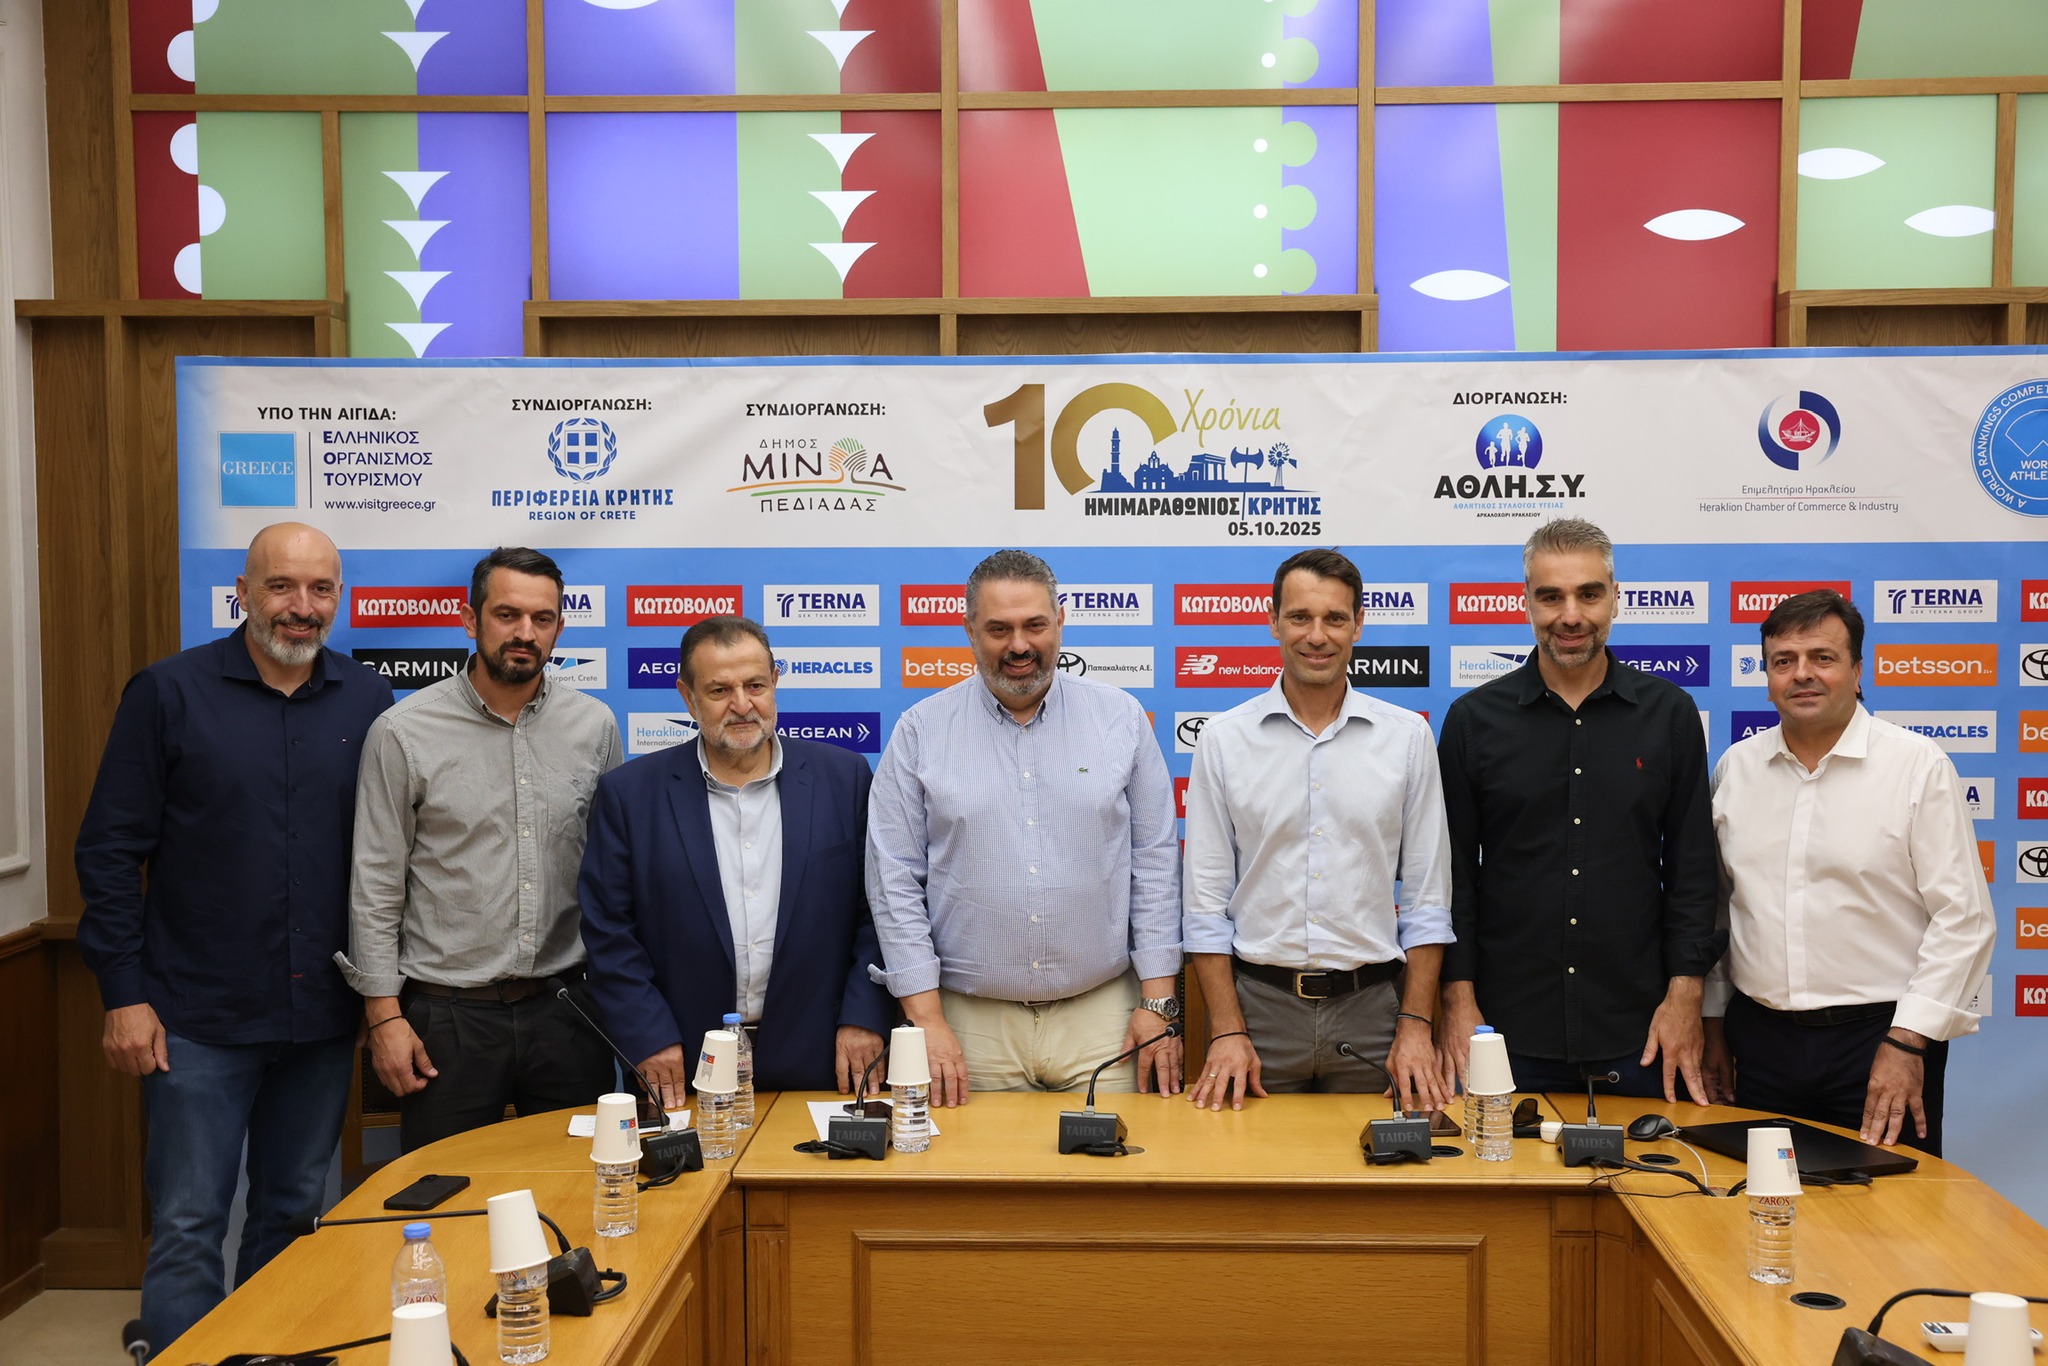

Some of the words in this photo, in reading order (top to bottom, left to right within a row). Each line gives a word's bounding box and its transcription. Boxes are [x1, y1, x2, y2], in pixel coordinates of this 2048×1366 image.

[1452, 392, 1567, 404] ΔΙΟΡΓΑΝΩΣΗ:
[2000, 384, 2048, 407] COMPET
[512, 399, 652, 411] ΣΥΝΔΙΟΡΓΑΝΩΣΗ:
[746, 404, 886, 416] ΣΥΝΔΙΟΡΓΑΝΩΣΗ:
[258, 407, 293, 420] ΥΠΟ
[299, 408, 332, 420] ΤΗΝ
[338, 408, 396, 420] ΑΙΓΙΔΑ:
[1182, 389, 1281, 448] Χρόνια
[323, 431, 420, 444] ΕΛΛΗΝΙΚΟΣ
[1977, 406, 2002, 466] RANKINGS
[760, 439, 817, 448] ΔΗΜΟΣ
[984, 382, 1178, 510] 10
[323, 452, 432, 465] ΟΡΓΑΝΙΣΜΟΣ
[2020, 460, 2048, 470] WOR
[222, 462, 294, 475] GREECE
[324, 473, 422, 486] ΤΟΥΡΙΣΜΟΥ
[2009, 471, 2048, 480] ATHLE
[1434, 474, 1586, 499] ΑΘΛΗ.Σ.Υ.
[1742, 485, 1803, 496] Επιμελητήριο
[1806, 484, 1856, 496] Ηρακλείου
[1982, 468, 2014, 504] WORLD
[492, 490, 599, 506] ΠΕΡΙΦΕΡΕΙΑ
[606, 489, 673, 505] ΚΡΗΤΗΣ
[2018, 498, 2027, 508] A
[324, 499, 436, 512] www.visitgreece.gr
[761, 498, 877, 512] ΠΕΔΙΑΔΑΣ
[1248, 497, 1321, 515] ΚΡΗΤΗΣ
[1700, 502, 1742, 512] Heraklion
[1744, 502, 1785, 512] Chamber
[1787, 502, 1796, 512] of
[1798, 502, 1846, 511] Commerce
[1849, 502, 1857, 511] &
[1859, 502, 1899, 513] Industry
[529, 511, 575, 520] REGION
[580, 511, 595, 520] OF
[600, 511, 636, 520] CRETE
[1228, 522, 1321, 536] 05.10.2025
[798, 593, 866, 609] TERNA
[1071, 593, 1139, 608] TERNA
[1362, 592, 1414, 608] ERNA
[1457, 595, 1526, 612] ΚΩΤΣΟΒΟ
[1624, 591, 1694, 606] TERNA
[1911, 589, 1983, 605] TERNA
[358, 598, 461, 616] ΚΩΤΣΟΒΟΛΟΣ
[634, 598, 735, 614] ΚΩΤΣΟΒΟΛΟΣ
[908, 597, 966, 613] ΚΩΤΣΟΒ
[1182, 596, 1273, 613] ΚΩΤΣΟΒΟΛΟ
[638, 663, 681, 674] AEG
[792, 662, 873, 674] HERACLES
[905, 659, 978, 676] betss
[1219, 667, 1242, 675] new
[1243, 665, 1282, 675] balanc
[1347, 659, 1418, 675] RMIN
[1459, 659, 1512, 670] Heraklion
[1619, 660, 1680, 671] GEAN
[1879, 657, 1982, 674] betsson
[636, 726, 689, 737] Heraklion
[778, 727, 852, 738] AEGEAN
[834, 1129, 877, 1141] TAIDEN
[1065, 1125, 1107, 1136] TAIDEN
[1378, 1132, 1423, 1143] TAIDEN
[1570, 1137, 1615, 1148] TAIDEN
[656, 1144, 694, 1159] TAIDEN
